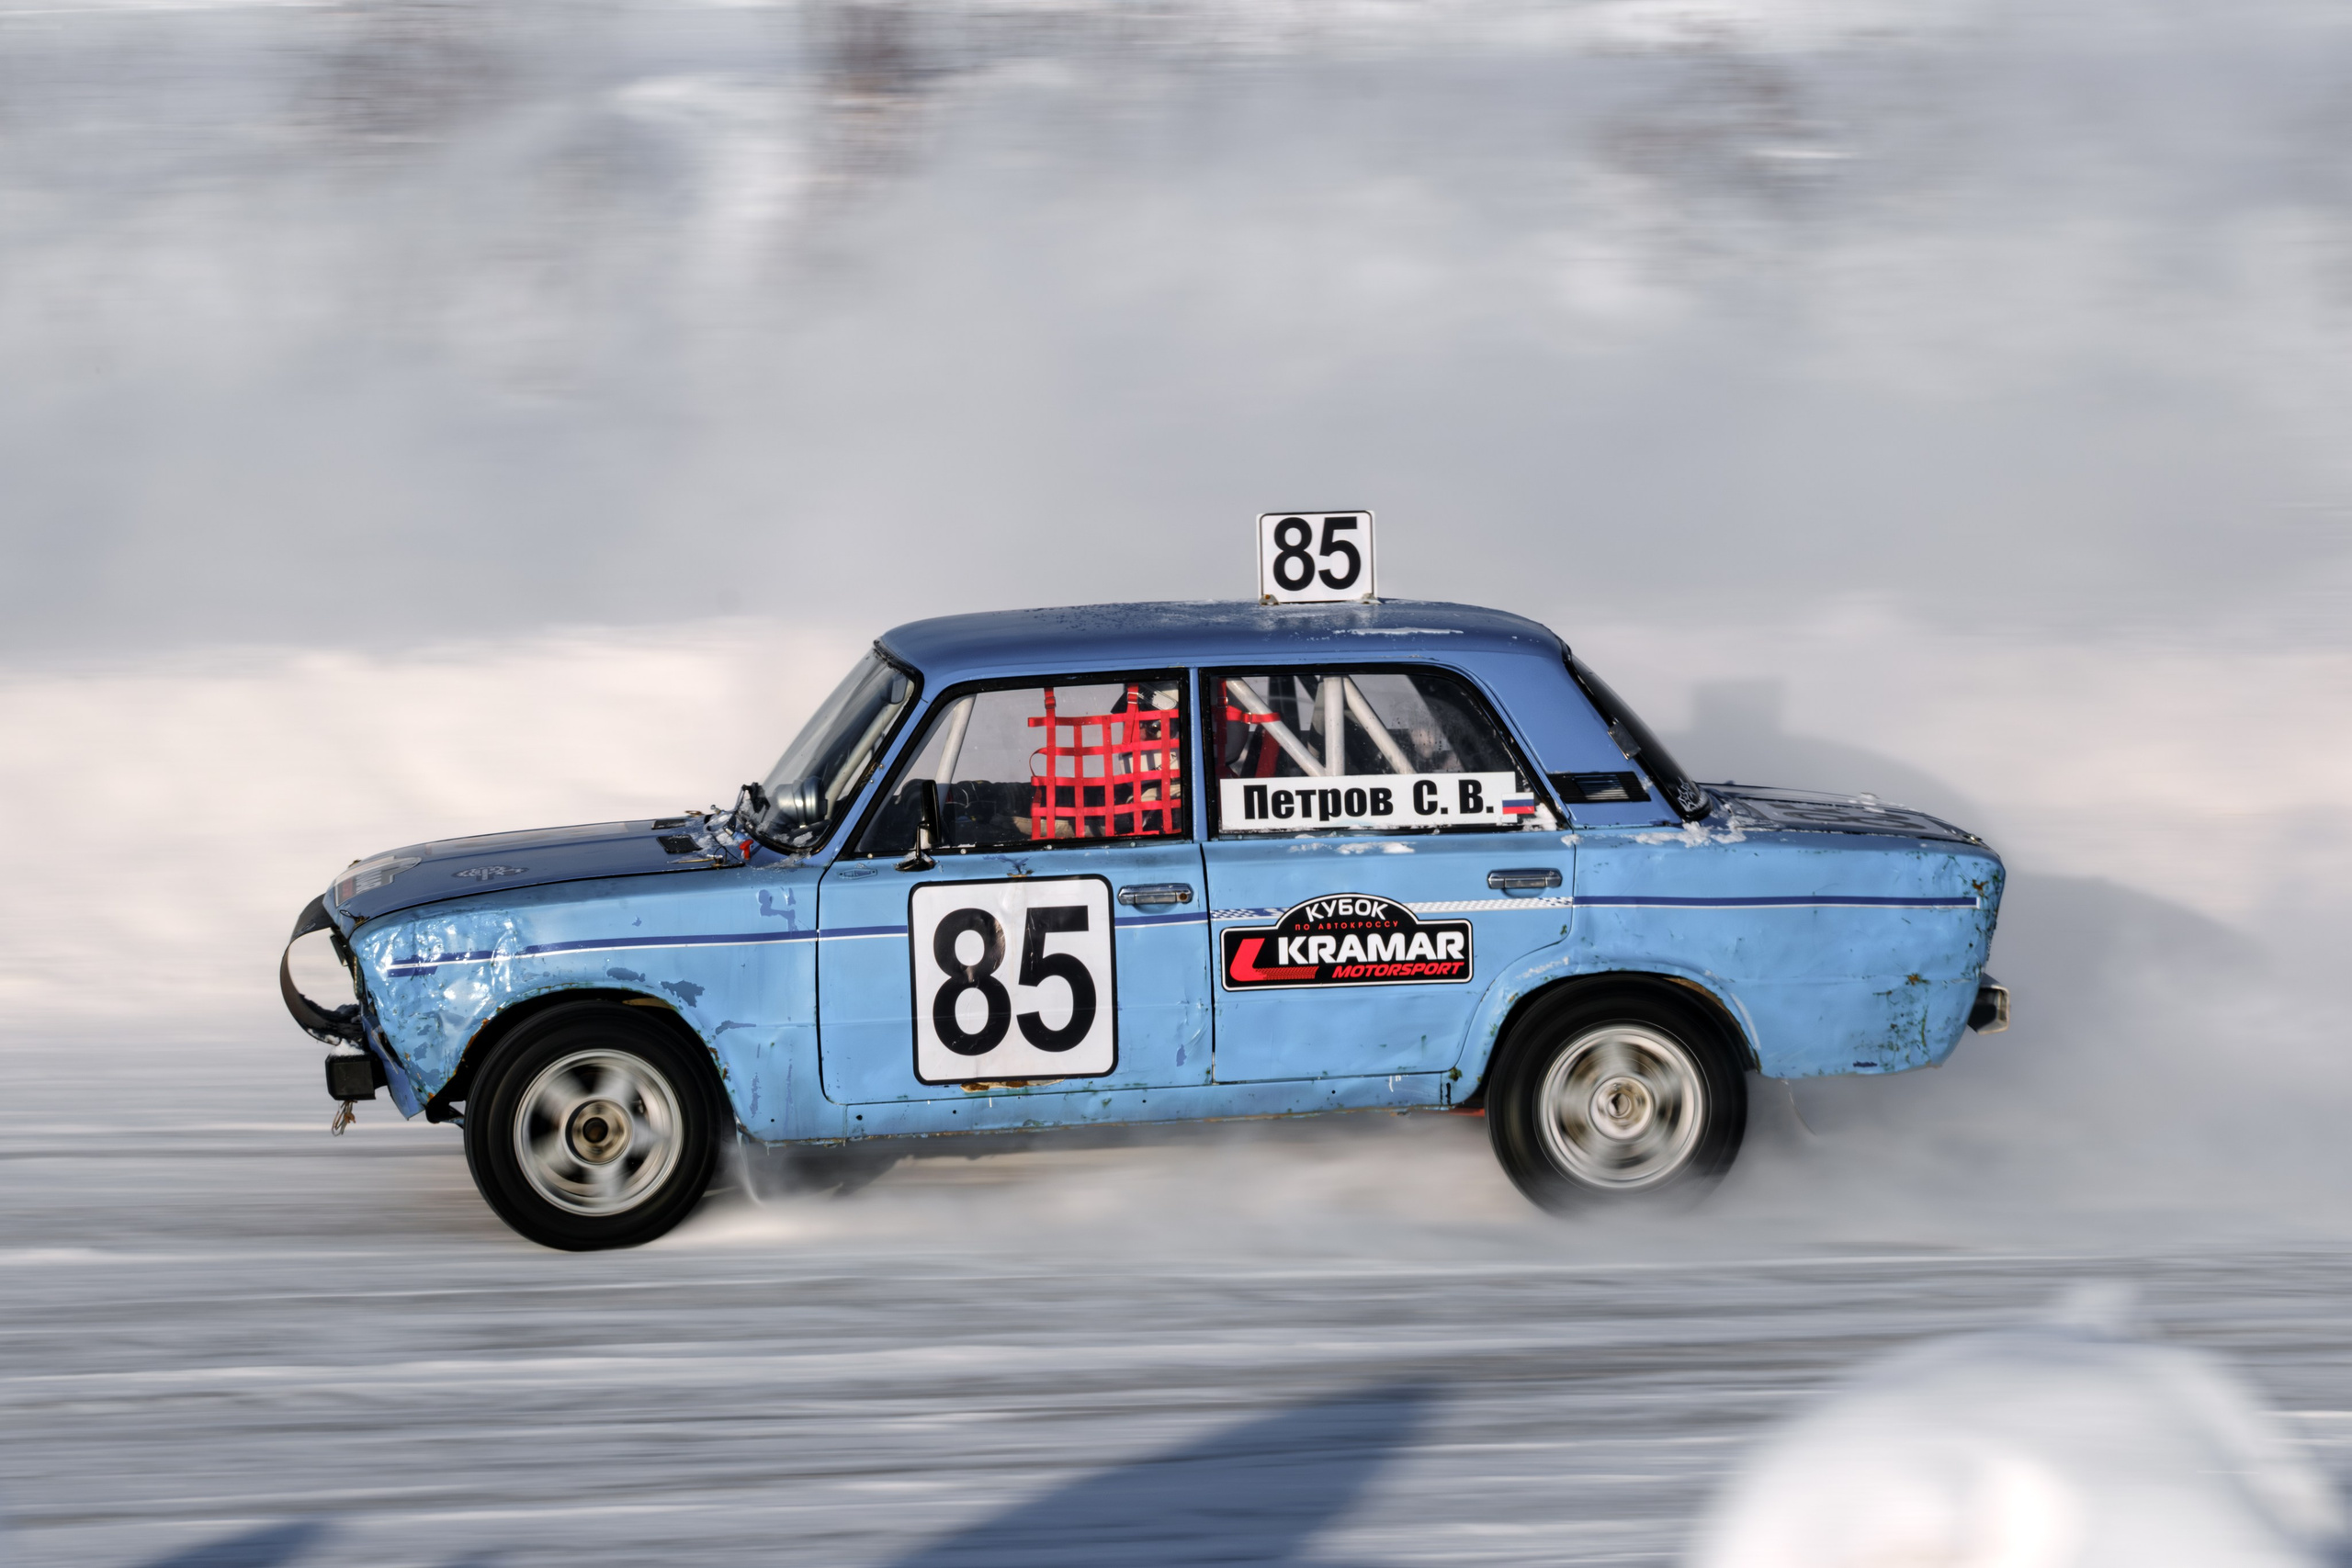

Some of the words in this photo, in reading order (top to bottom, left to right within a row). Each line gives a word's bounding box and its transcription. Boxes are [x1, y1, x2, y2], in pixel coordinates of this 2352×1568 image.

[1272, 516, 1362, 592] 85
[1243, 784, 1394, 821] Петров
[1412, 779, 1449, 816] С.
[1458, 778, 1495, 815] В.
[1305, 898, 1389, 923] КУБОК
[1317, 920, 1398, 931] АВТОКРОССУ
[1278, 931, 1465, 965] KRAMAR
[932, 905, 1097, 1056] 85
[1331, 961, 1465, 979] MOTORSPORT
